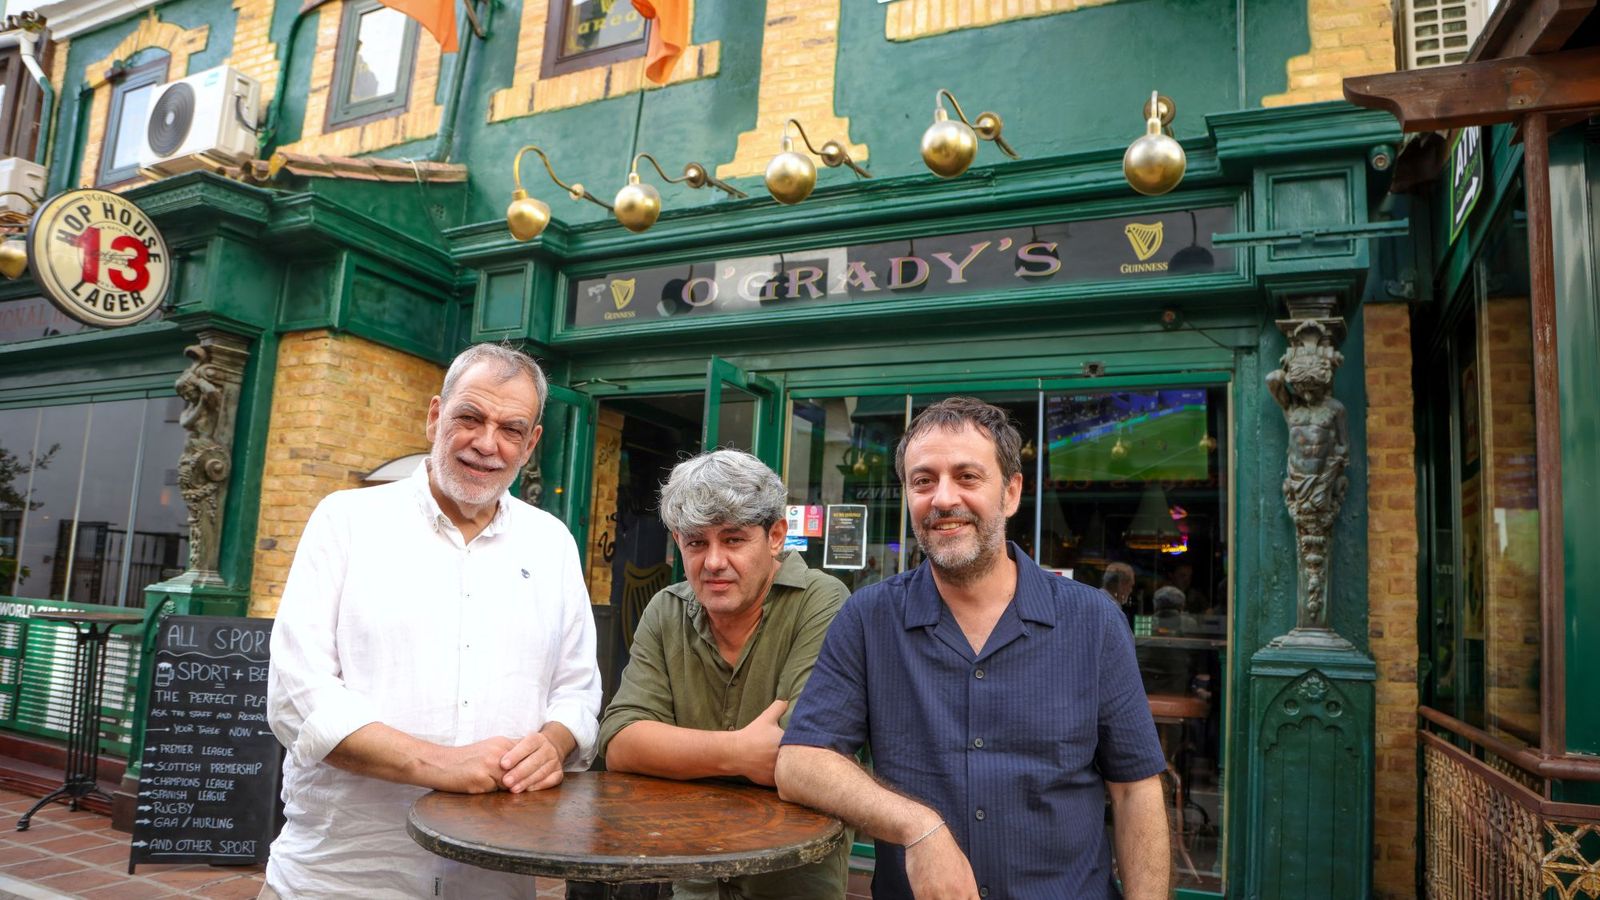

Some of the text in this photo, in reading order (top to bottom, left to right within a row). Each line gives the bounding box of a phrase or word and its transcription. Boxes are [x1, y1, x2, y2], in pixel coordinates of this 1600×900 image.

[1454, 126, 1479, 188] ATM
[56, 201, 162, 265] HOP HOUSE
[72, 226, 151, 292] 13
[681, 237, 1062, 307] O'GRADY'S
[1120, 261, 1169, 274] GUINNESS
[70, 279, 147, 312] LAGER
[603, 309, 636, 321] GUINNESS
[167, 624, 198, 648] ALL
[177, 661, 231, 682] SPORT
[155, 690, 179, 703] THE
[188, 691, 238, 706] PERFECT
[150, 708, 168, 717] ASK
[171, 709, 185, 718] THE
[189, 710, 213, 718] STAFF
[216, 711, 232, 720] AND
[173, 723, 253, 737] YOUR TABLE NOW
[160, 744, 234, 757] PREMIER LEAGUE
[154, 761, 263, 775] SCOTTISH PREMIERSHIP
[153, 777, 235, 790] CHAMPIONS LEAGUE
[151, 790, 227, 801] SPANISH LEAGUE
[152, 802, 194, 815] RUGBY
[153, 816, 178, 828] GAA
[192, 816, 234, 829] HURLING
[149, 838, 257, 854] AND OTHER SPORT
